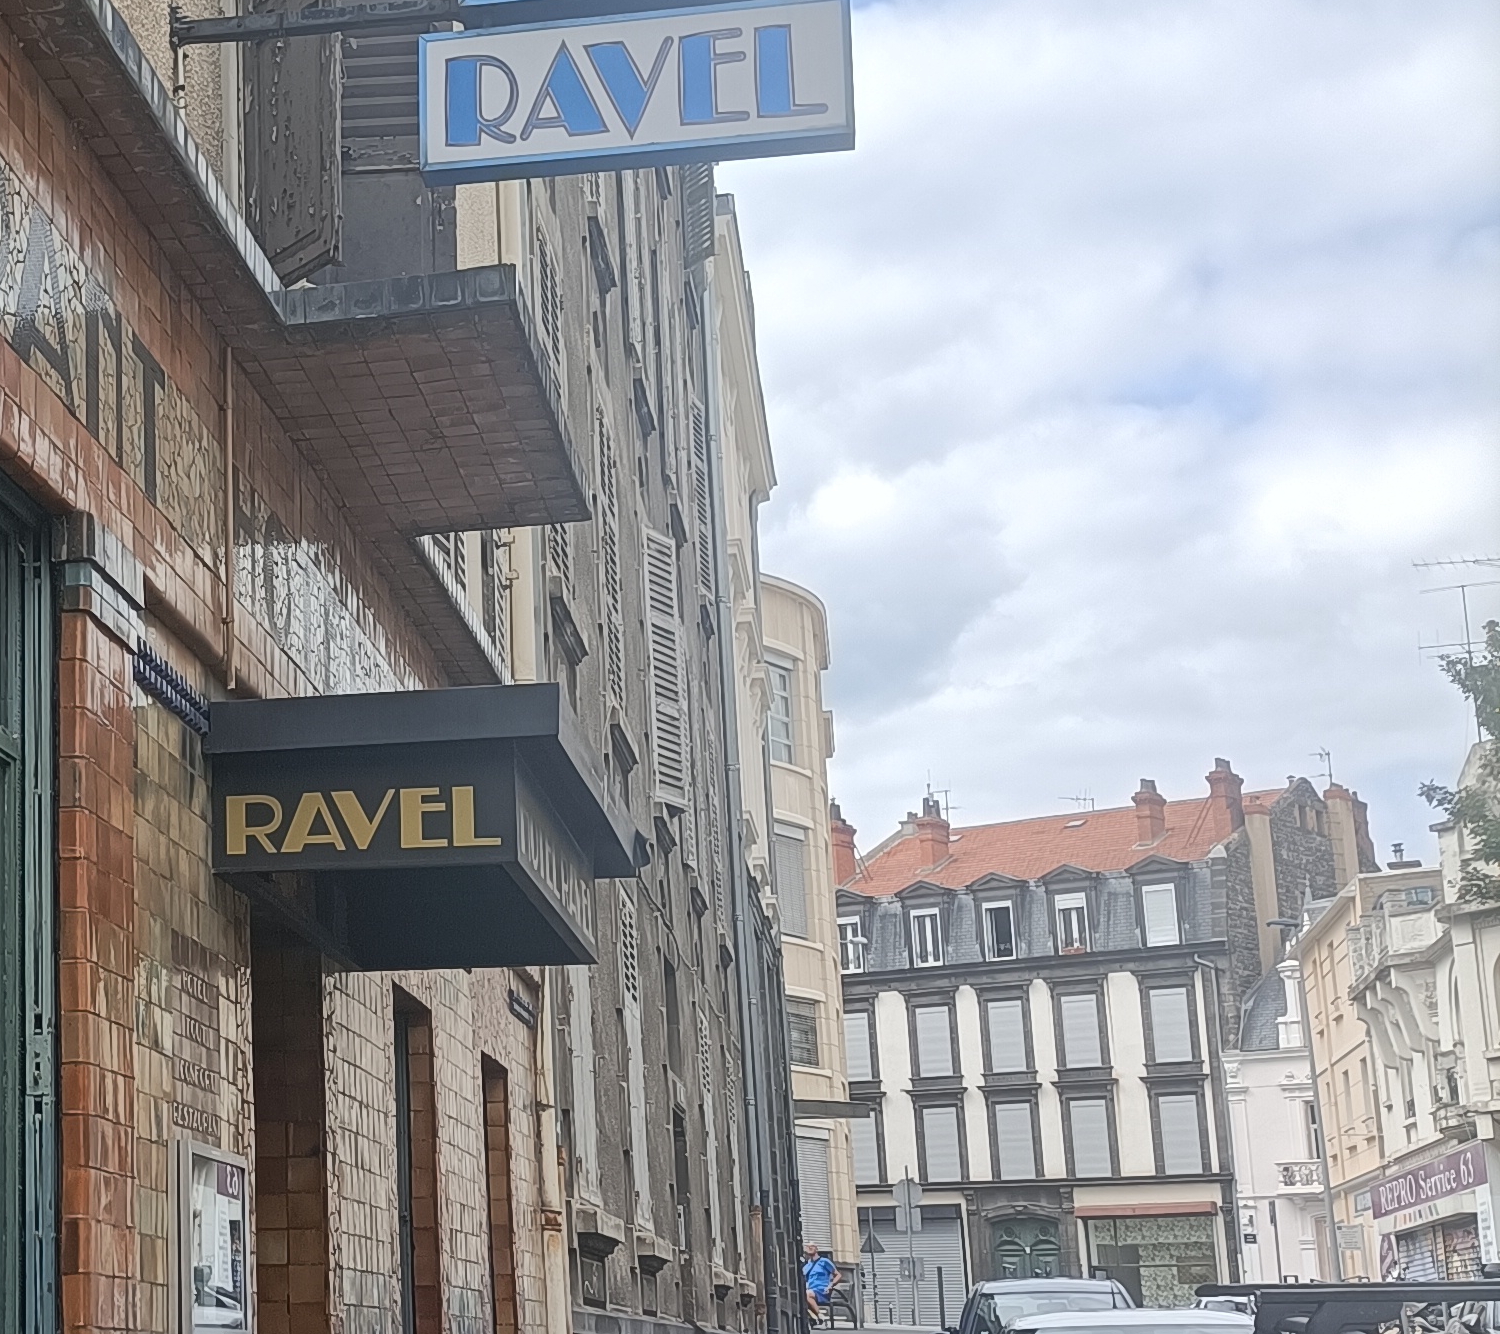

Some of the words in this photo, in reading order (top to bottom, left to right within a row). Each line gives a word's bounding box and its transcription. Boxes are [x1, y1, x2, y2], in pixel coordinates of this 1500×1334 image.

[444, 23, 829, 147] RAVEL
[225, 785, 502, 855] RAVEL
[182, 970, 210, 1003] HOTEL
[1378, 1174, 1416, 1213] REPRO
[1418, 1163, 1457, 1199] Service
[1459, 1152, 1474, 1186] 63
